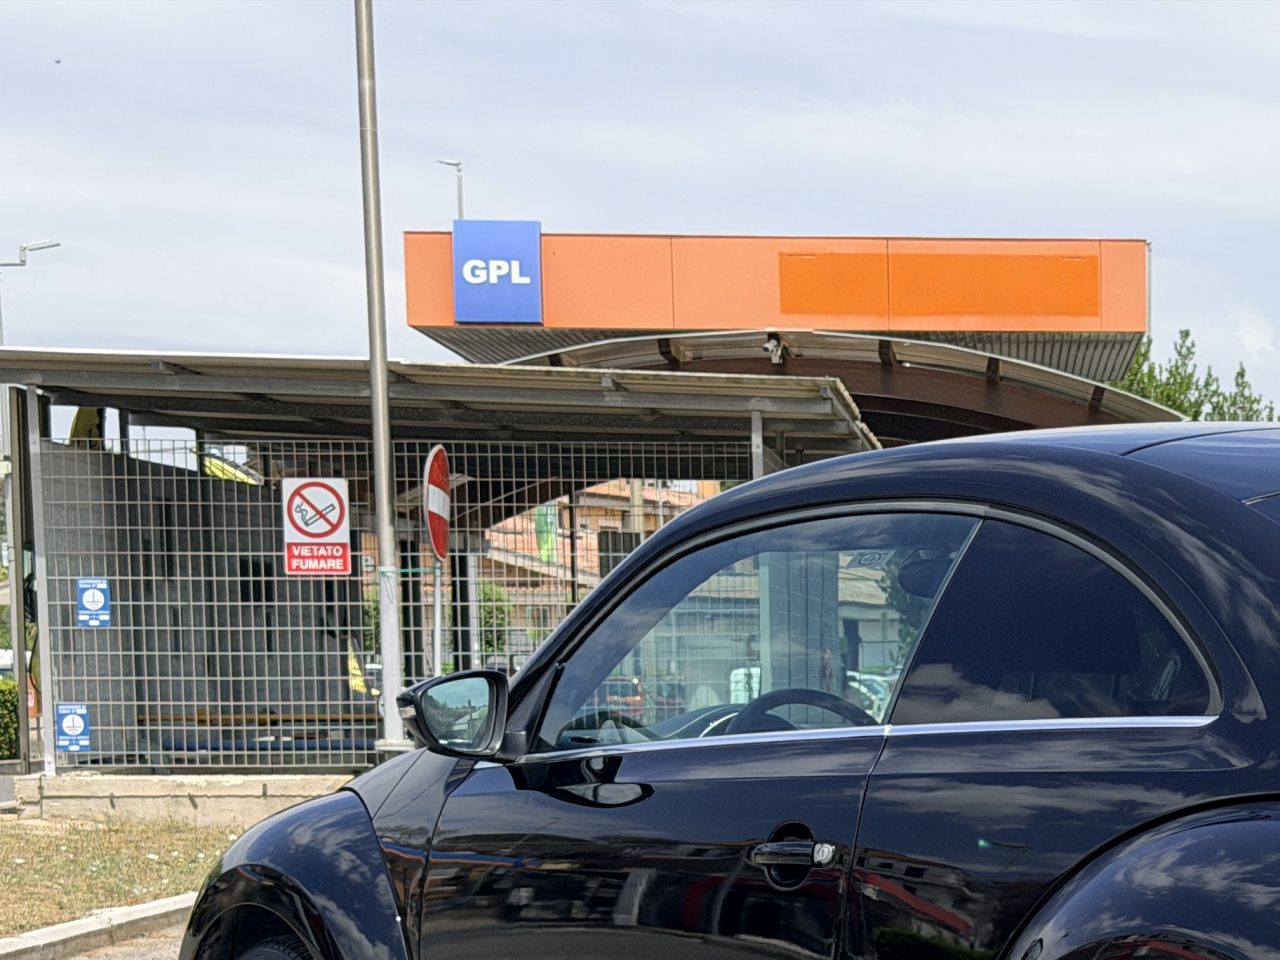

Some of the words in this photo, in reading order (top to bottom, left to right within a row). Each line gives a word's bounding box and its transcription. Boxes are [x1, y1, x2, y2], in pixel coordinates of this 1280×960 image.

[462, 259, 531, 285] GPL
[292, 545, 343, 557] VIETATO
[292, 558, 344, 570] FUMARE
